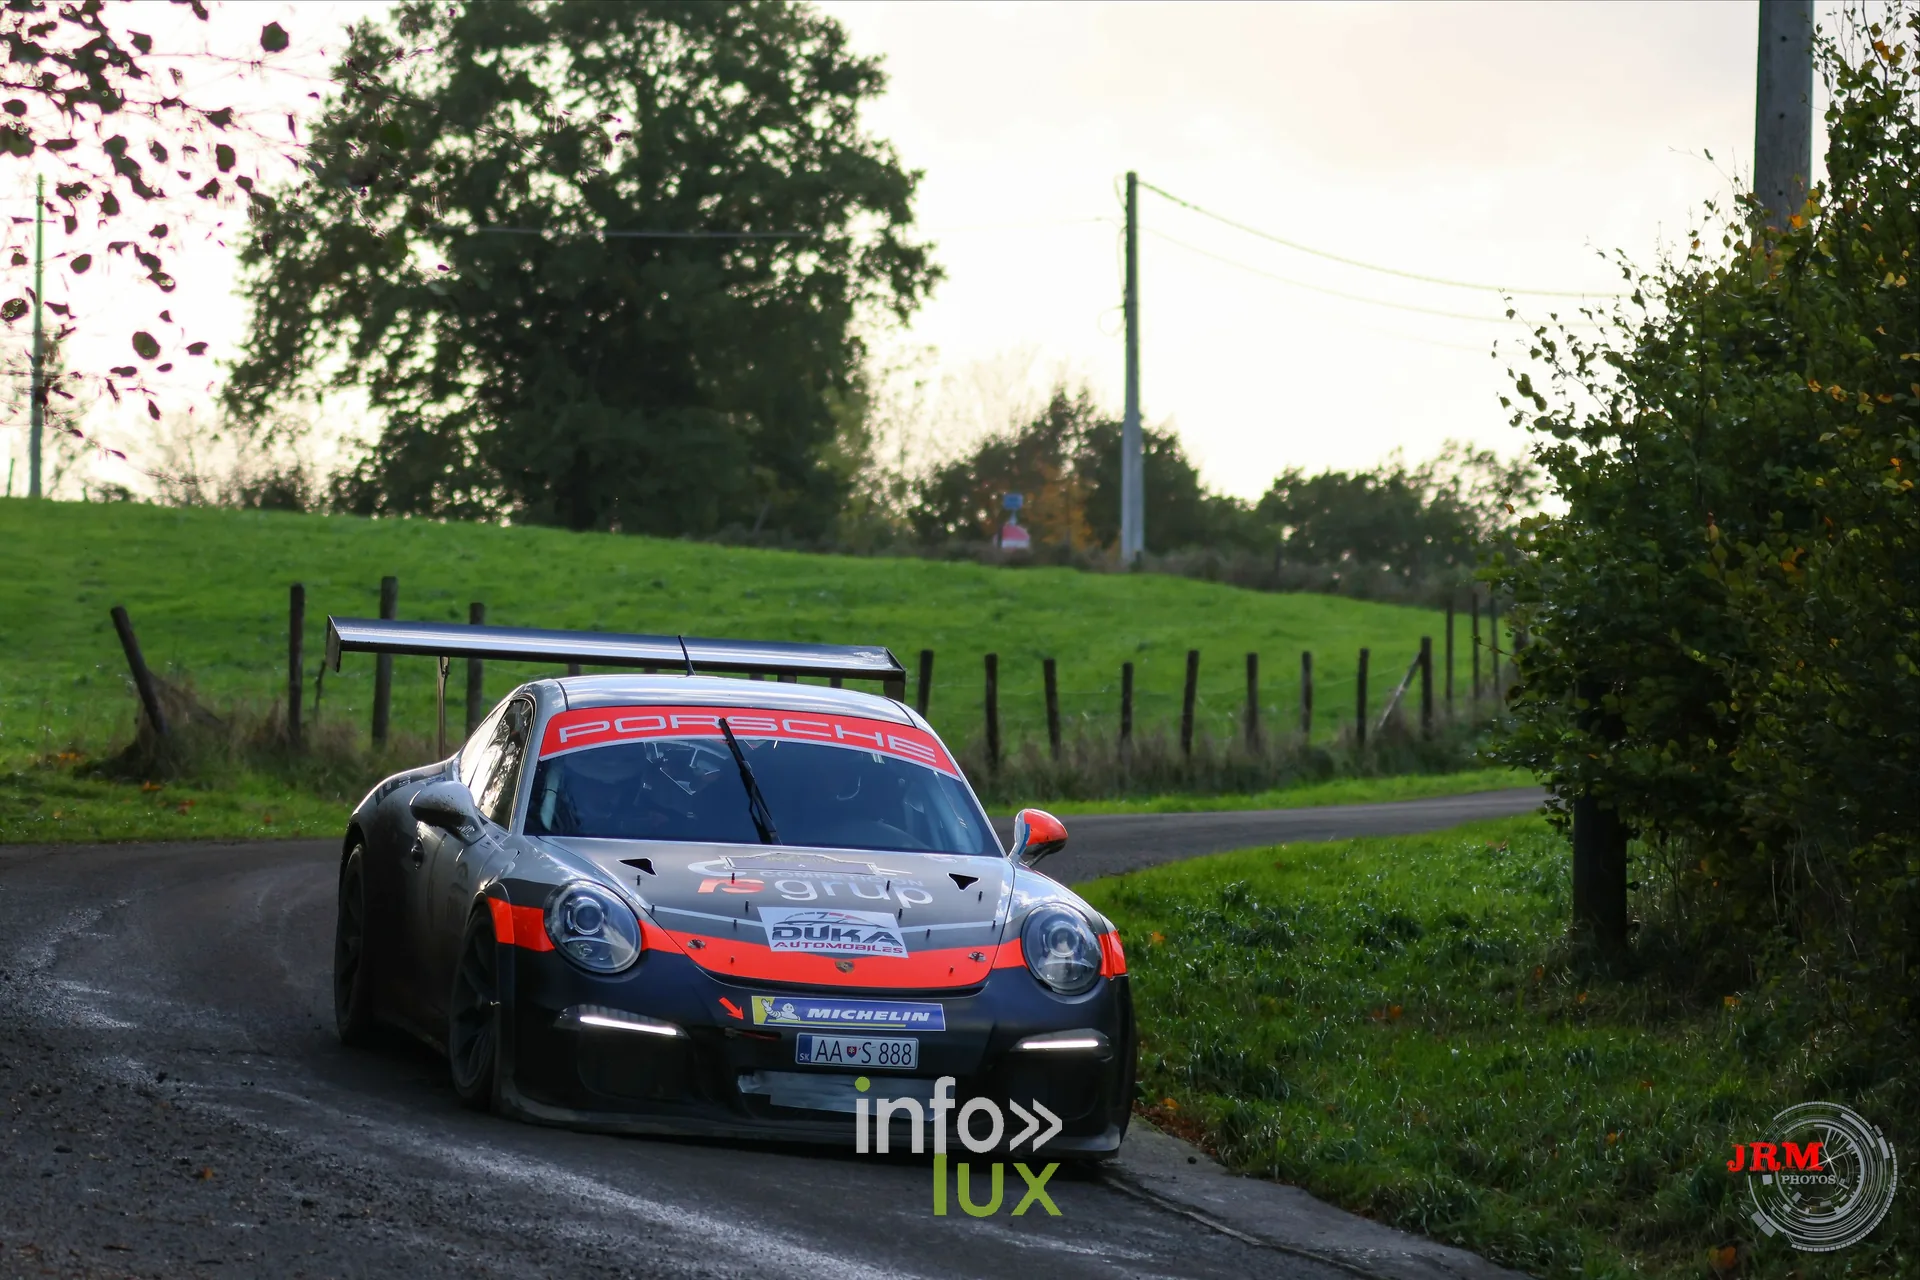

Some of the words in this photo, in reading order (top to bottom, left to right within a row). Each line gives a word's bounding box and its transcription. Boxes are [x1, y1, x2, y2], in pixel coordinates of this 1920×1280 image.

[559, 714, 936, 763] PORSCHE
[772, 925, 903, 946] DUKA
[807, 1008, 930, 1022] MICHELIN
[815, 1039, 843, 1063] AA
[878, 1042, 912, 1066] 888
